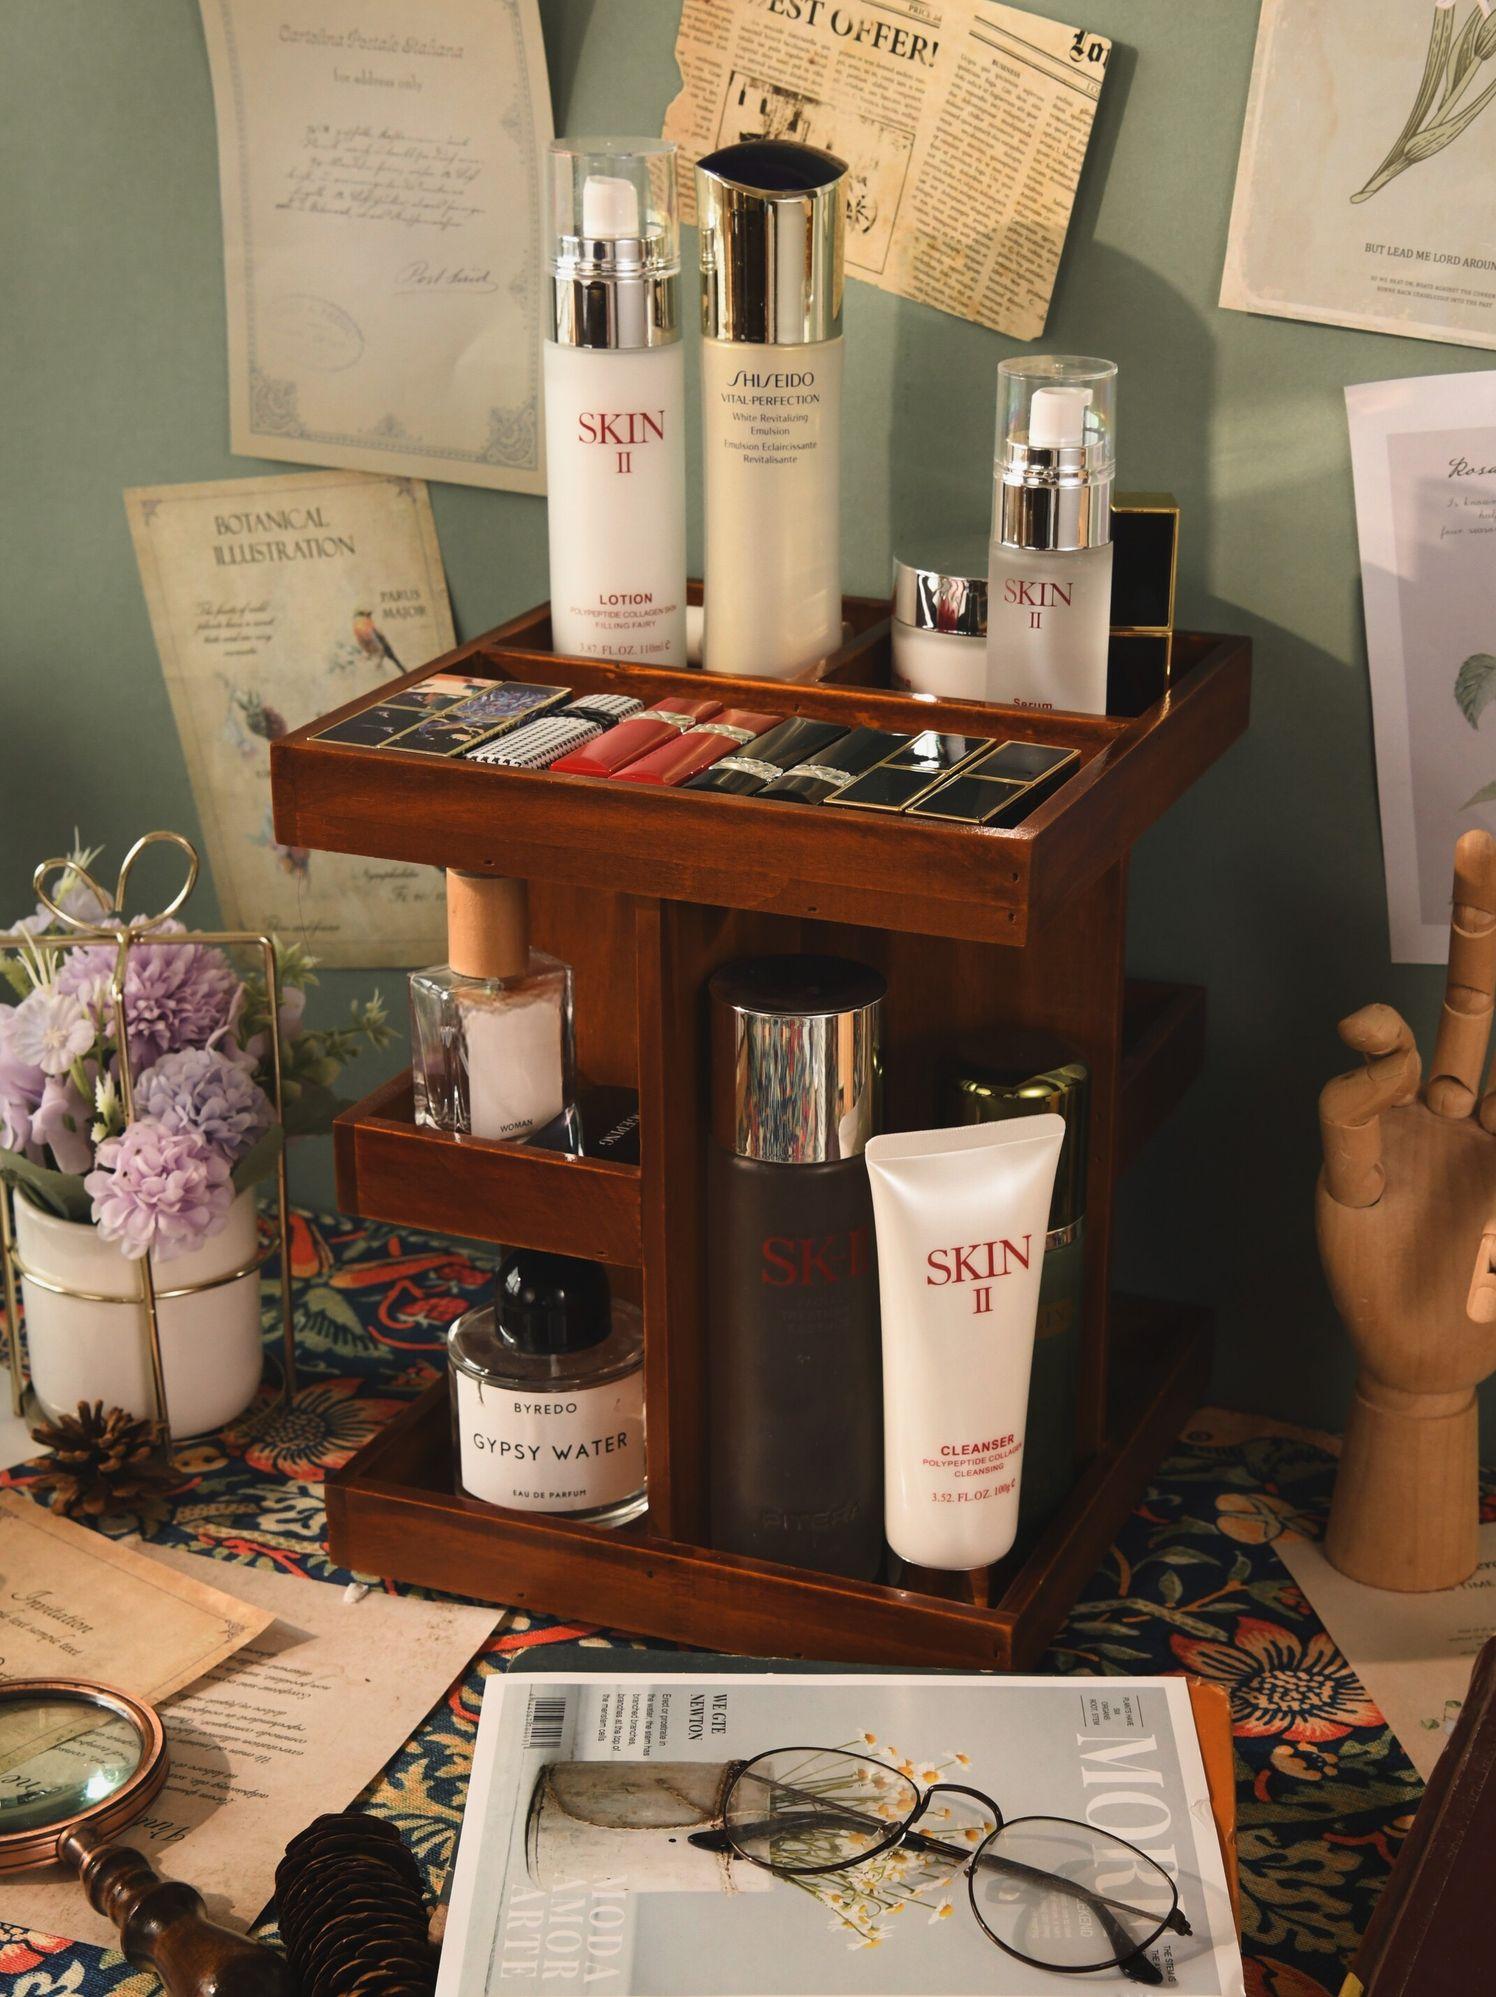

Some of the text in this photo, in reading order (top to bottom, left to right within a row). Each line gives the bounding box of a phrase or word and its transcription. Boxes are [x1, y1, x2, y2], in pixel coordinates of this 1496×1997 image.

[760, 0, 825, 26] EST
[831, 9, 939, 67] OFFER!
[1364, 242, 1385, 255] BUT
[1387, 245, 1414, 259] LEAD
[1416, 249, 1432, 262] ME
[1433, 252, 1460, 266] LORD
[727, 370, 815, 388] SHISEIDO
[720, 393, 821, 406] VITAL-PERFECTION
[578, 409, 665, 444] SKIN
[732, 412, 809, 423] White Revitalizing
[750, 426, 790, 436] Emulsion
[724, 439, 760, 451] Emulsion
[616, 451, 632, 474] II
[214, 507, 331, 536] BOTANICAL
[213, 536, 356, 567] ILLUSTRATION
[599, 592, 653, 606] LOTION
[1004, 577, 1074, 607] SKIN
[1028, 612, 1042, 629] II
[500, 1119, 534, 1133] WOMAN
[926, 1234, 1032, 1286] SKIN
[972, 1287, 993, 1314] II
[514, 1402, 577, 1415] BYREDO
[473, 1431, 628, 1461] GYPSY WATER
[940, 1433, 1015, 1456] CLEANSER
[922, 1457, 987, 1467] POLYPEPTIDE
[954, 1463, 1004, 1478] CLEANSING
[512, 1489, 587, 1499] EAU DE PARFUM
[11, 1590, 93, 1634] Invitation
[688, 1694, 705, 1741] NEWTON
[711, 1694, 727, 1734] WE GTE
[614, 1725, 623, 1735] the
[645, 1720, 654, 1730] the
[611, 1735, 622, 1745] top
[642, 1745, 652, 1757] has
[500, 1883, 546, 1979] ARTE
[541, 1872, 587, 1980] AMOR
[583, 1873, 628, 1983] MODA
[1163, 1945, 1173, 1957] THE
